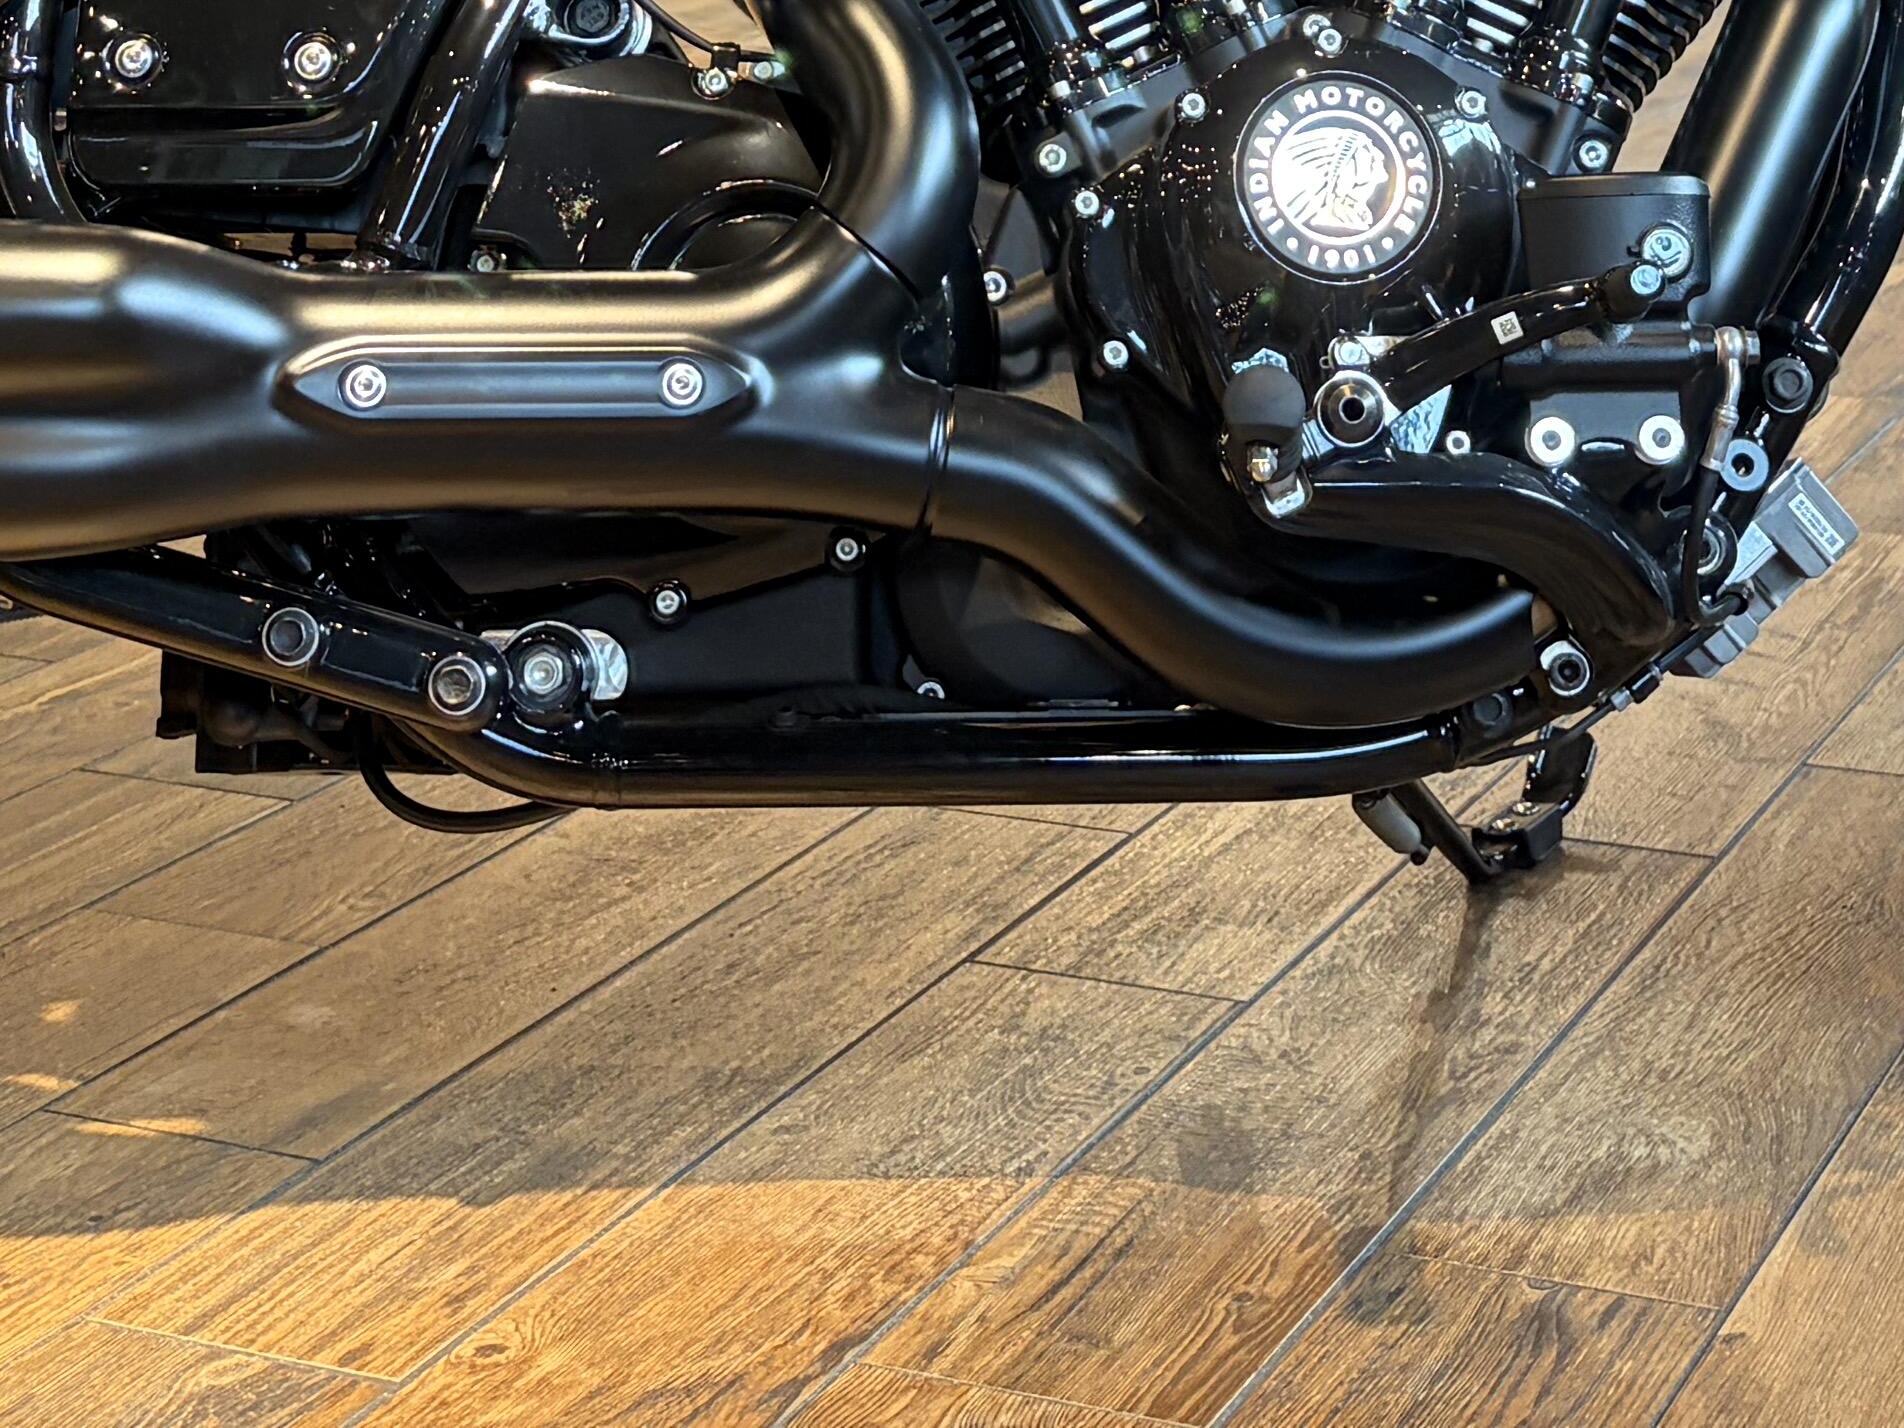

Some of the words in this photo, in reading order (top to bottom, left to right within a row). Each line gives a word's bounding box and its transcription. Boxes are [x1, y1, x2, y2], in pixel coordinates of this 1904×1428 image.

[1247, 109, 1290, 235] INDIAN
[1293, 85, 1428, 235] MOTORCYCLE
[1306, 243, 1377, 269] 1901
